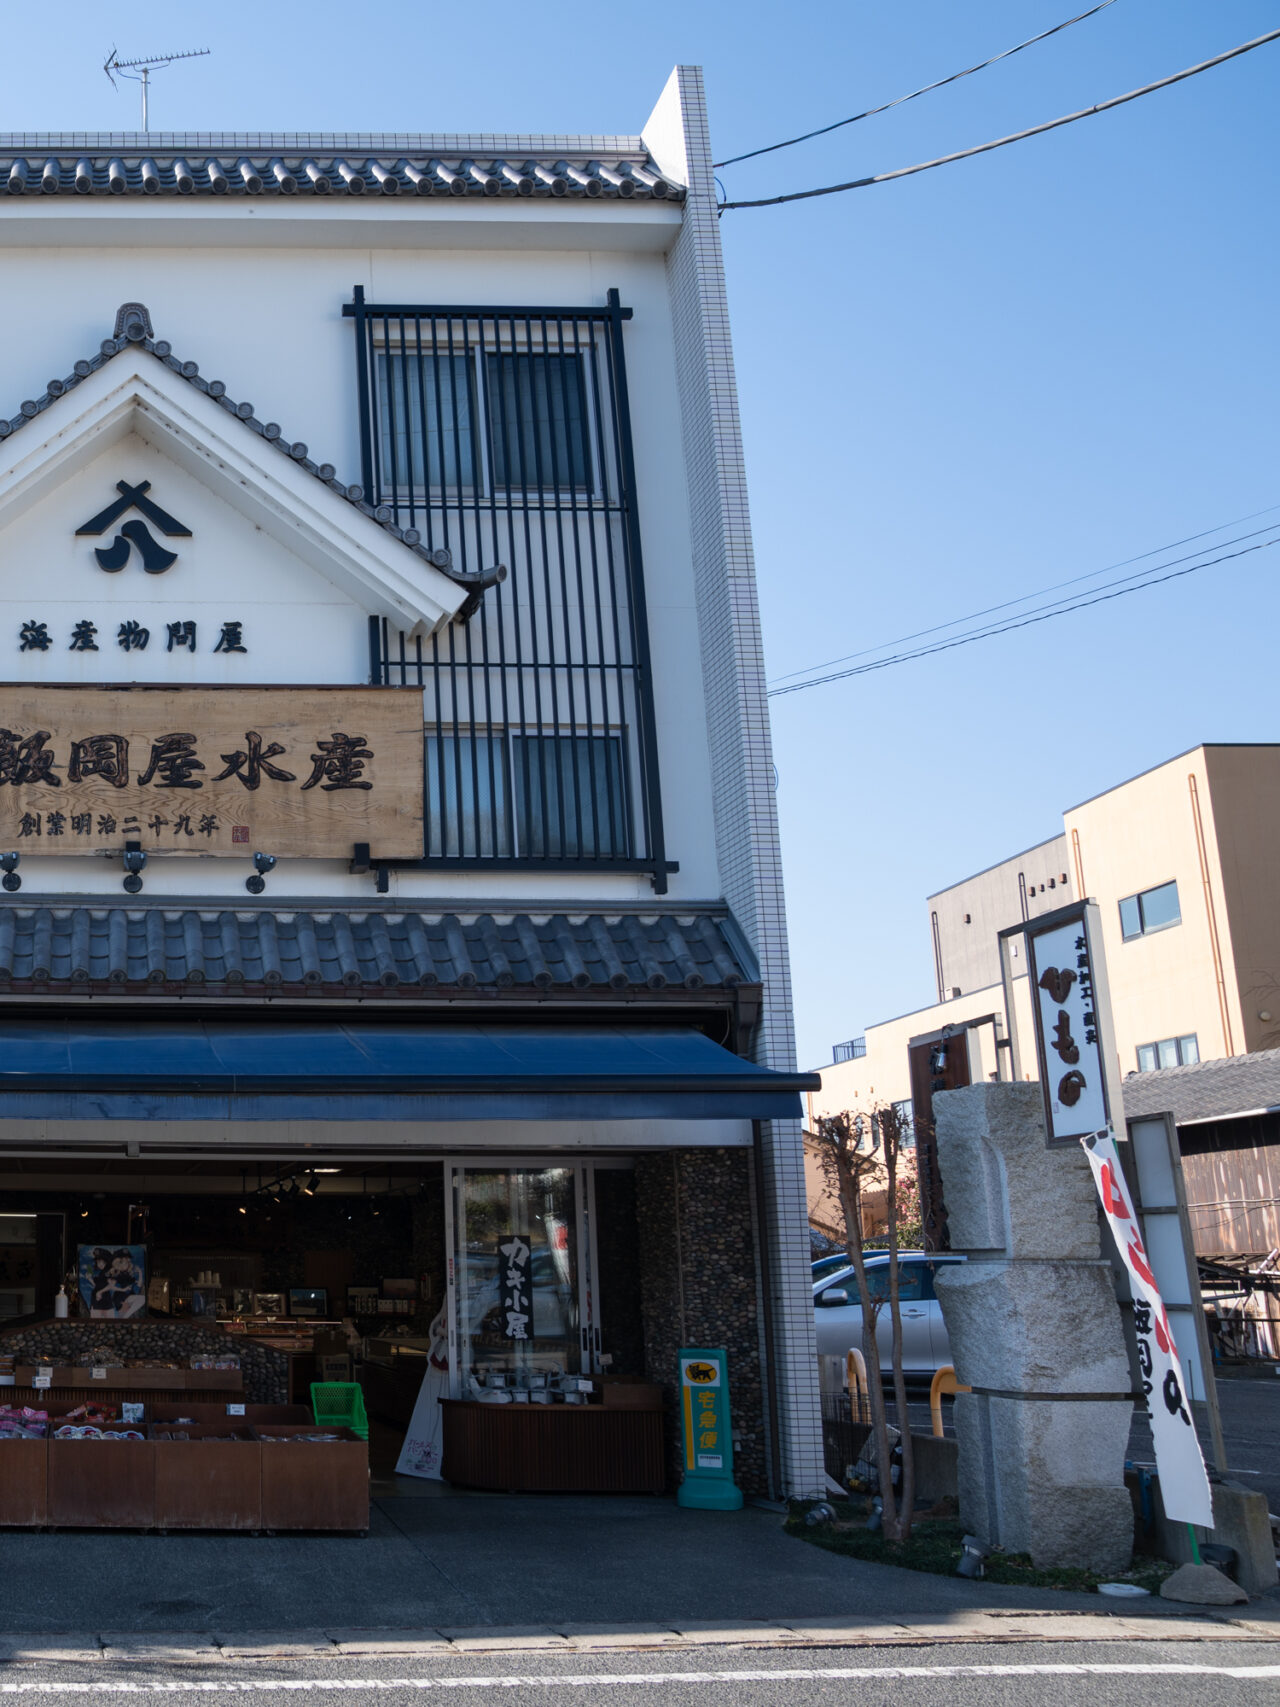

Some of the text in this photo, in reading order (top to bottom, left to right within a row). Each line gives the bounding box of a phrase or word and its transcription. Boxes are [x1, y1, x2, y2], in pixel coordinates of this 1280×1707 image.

[19, 619, 248, 654] 海産物問屋
[19, 814, 220, 838] 創業明治二十九年
[1038, 966, 1087, 1107] ひもの
[499, 1236, 531, 1339] カキ小屋
[697, 1390, 718, 1449] 宅急便
